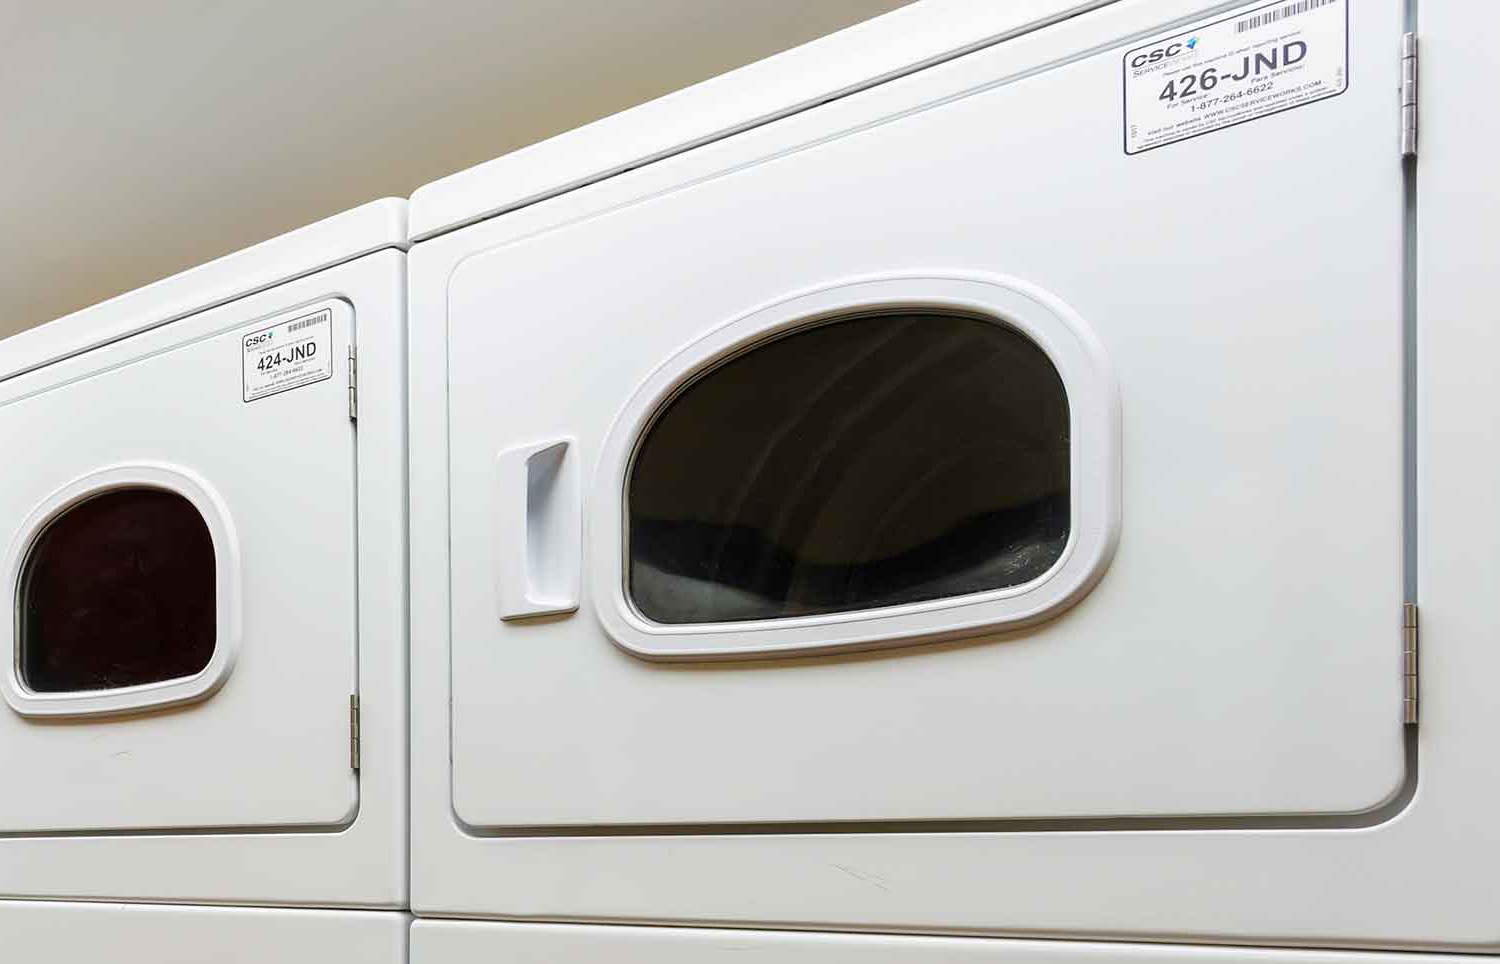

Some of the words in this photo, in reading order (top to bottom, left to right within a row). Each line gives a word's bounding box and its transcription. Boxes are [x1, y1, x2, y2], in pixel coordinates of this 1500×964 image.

[1131, 43, 1182, 68] CSC
[1158, 41, 1307, 101] 426-JND
[1190, 81, 1274, 112] 1-877-264-6622
[246, 334, 267, 347] CSC
[257, 342, 317, 371] 424-JND
